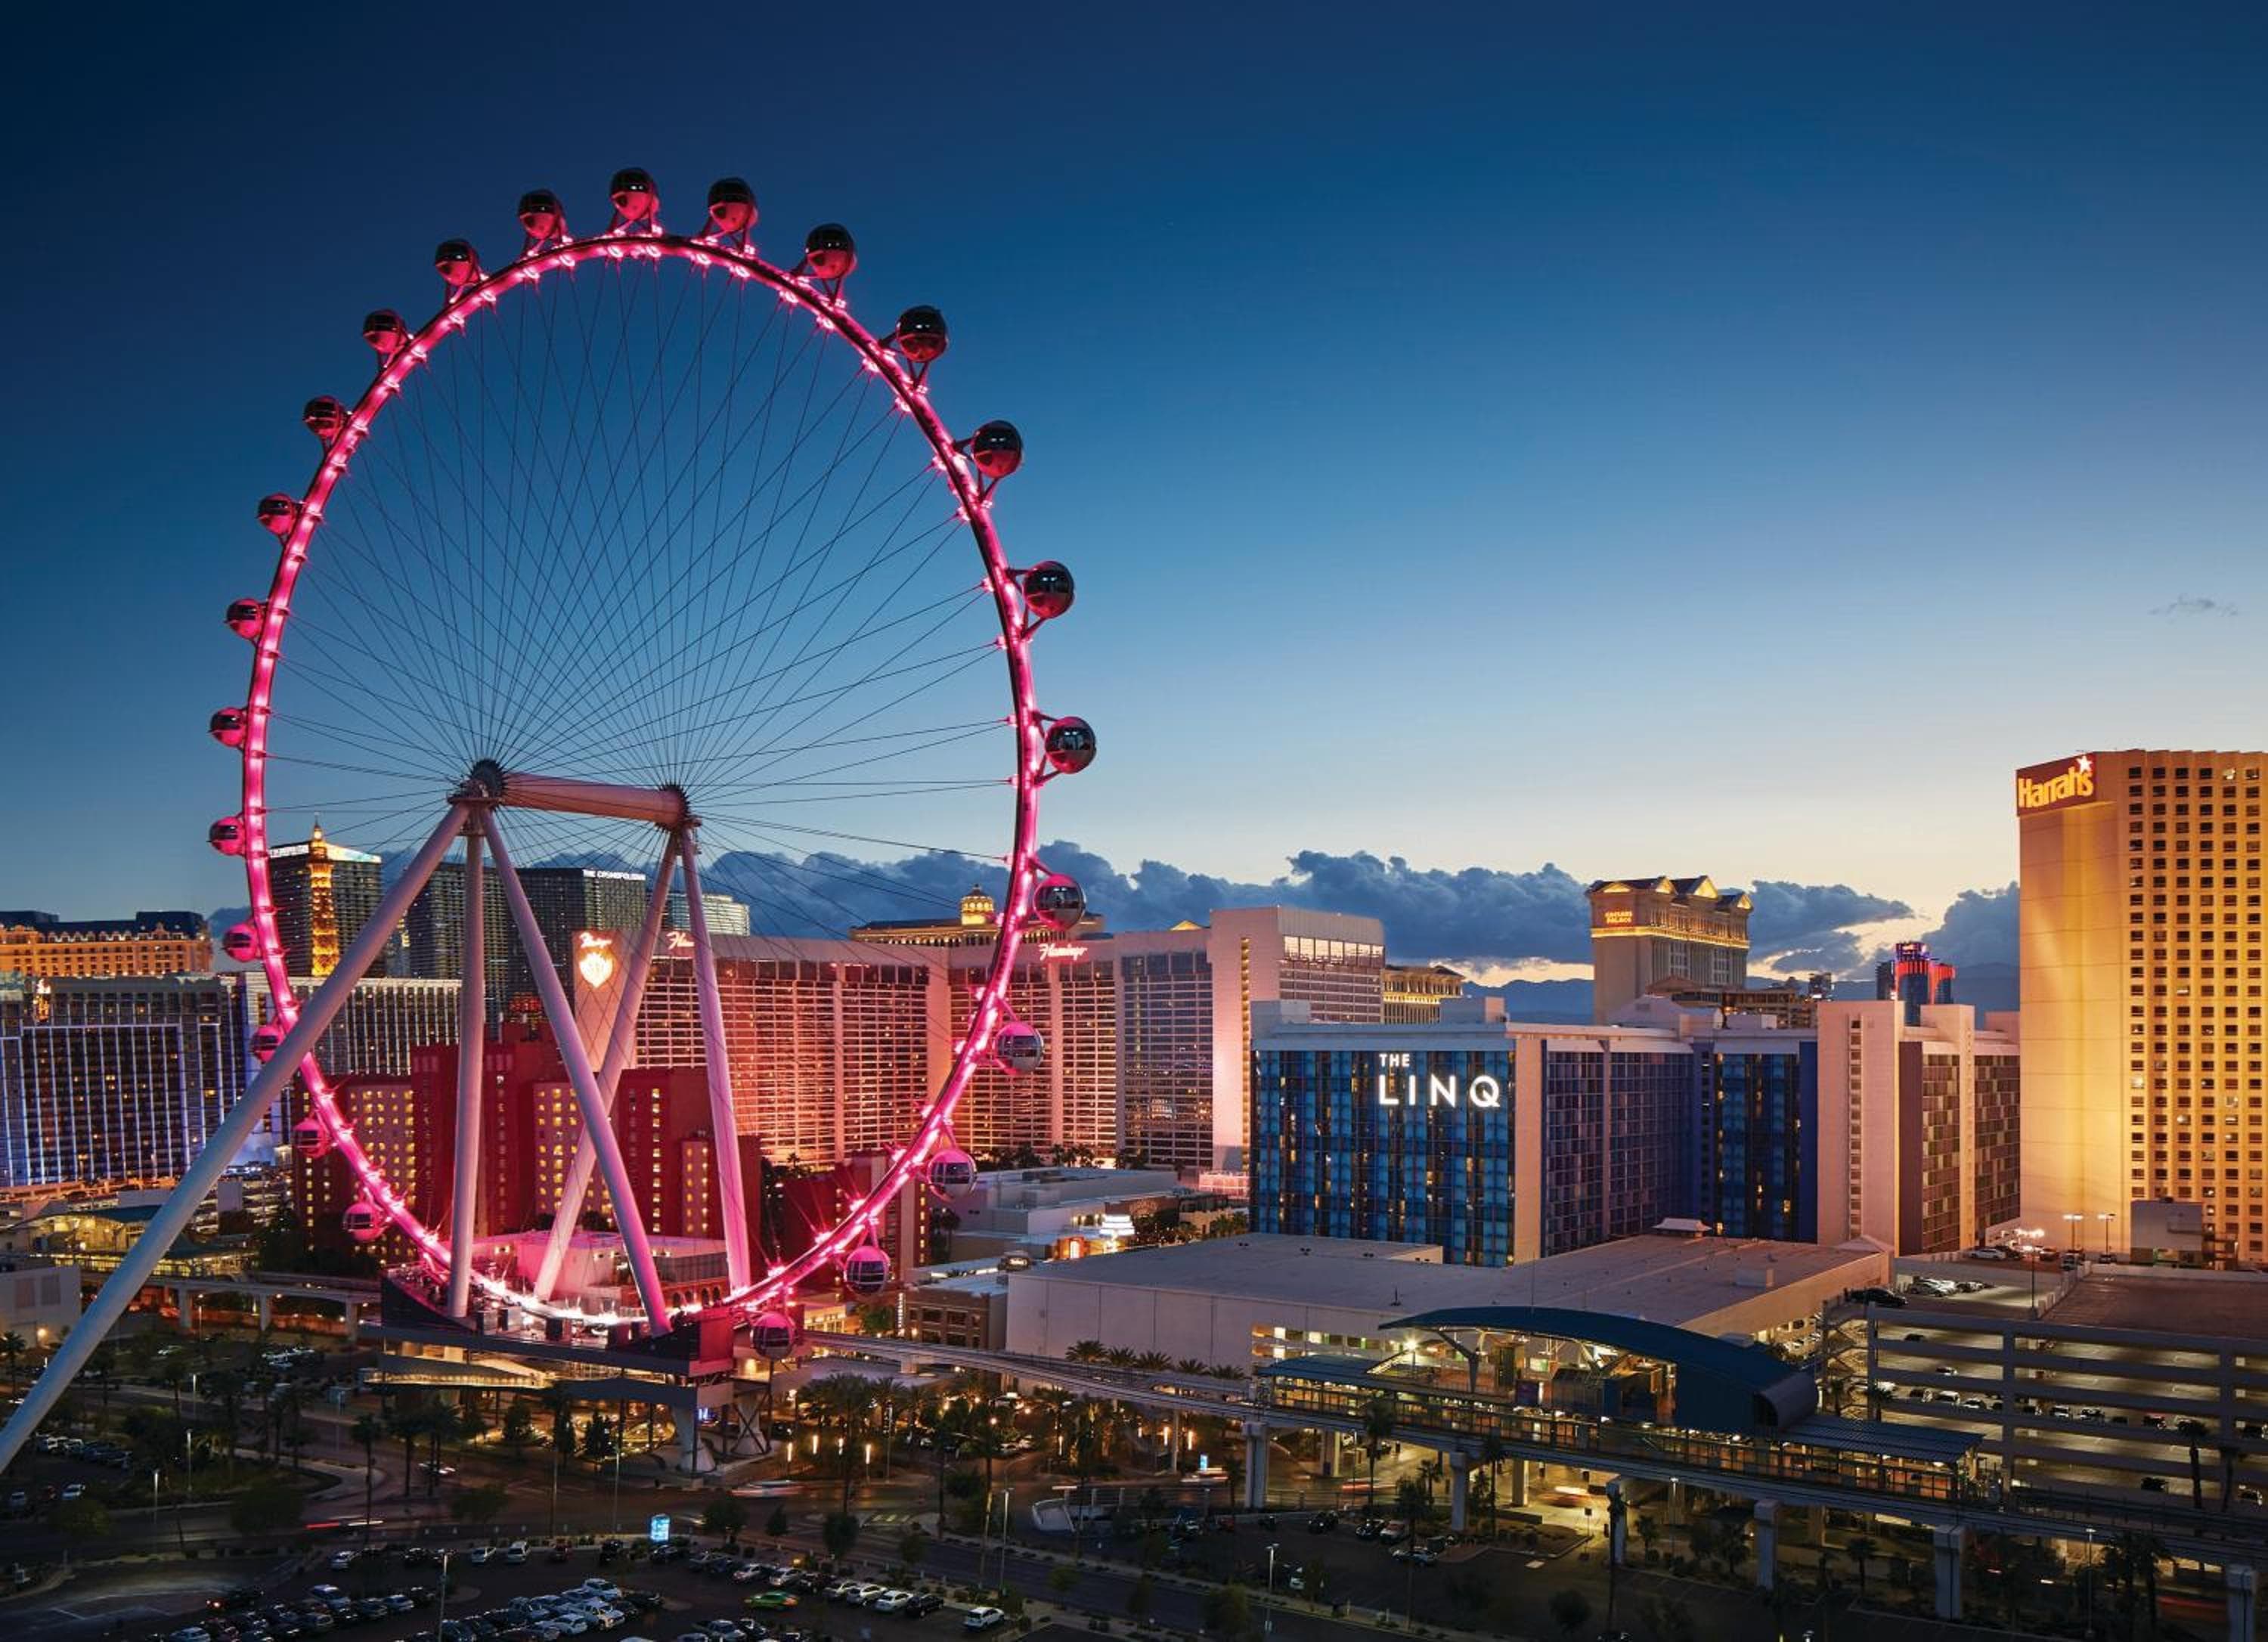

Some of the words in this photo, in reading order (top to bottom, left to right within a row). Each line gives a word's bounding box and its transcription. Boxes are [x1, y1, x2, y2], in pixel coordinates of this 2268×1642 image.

[1038, 943, 1089, 961] Flamingo
[1379, 1053, 1411, 1067] THE
[1379, 1073, 1501, 1108] LINQ
